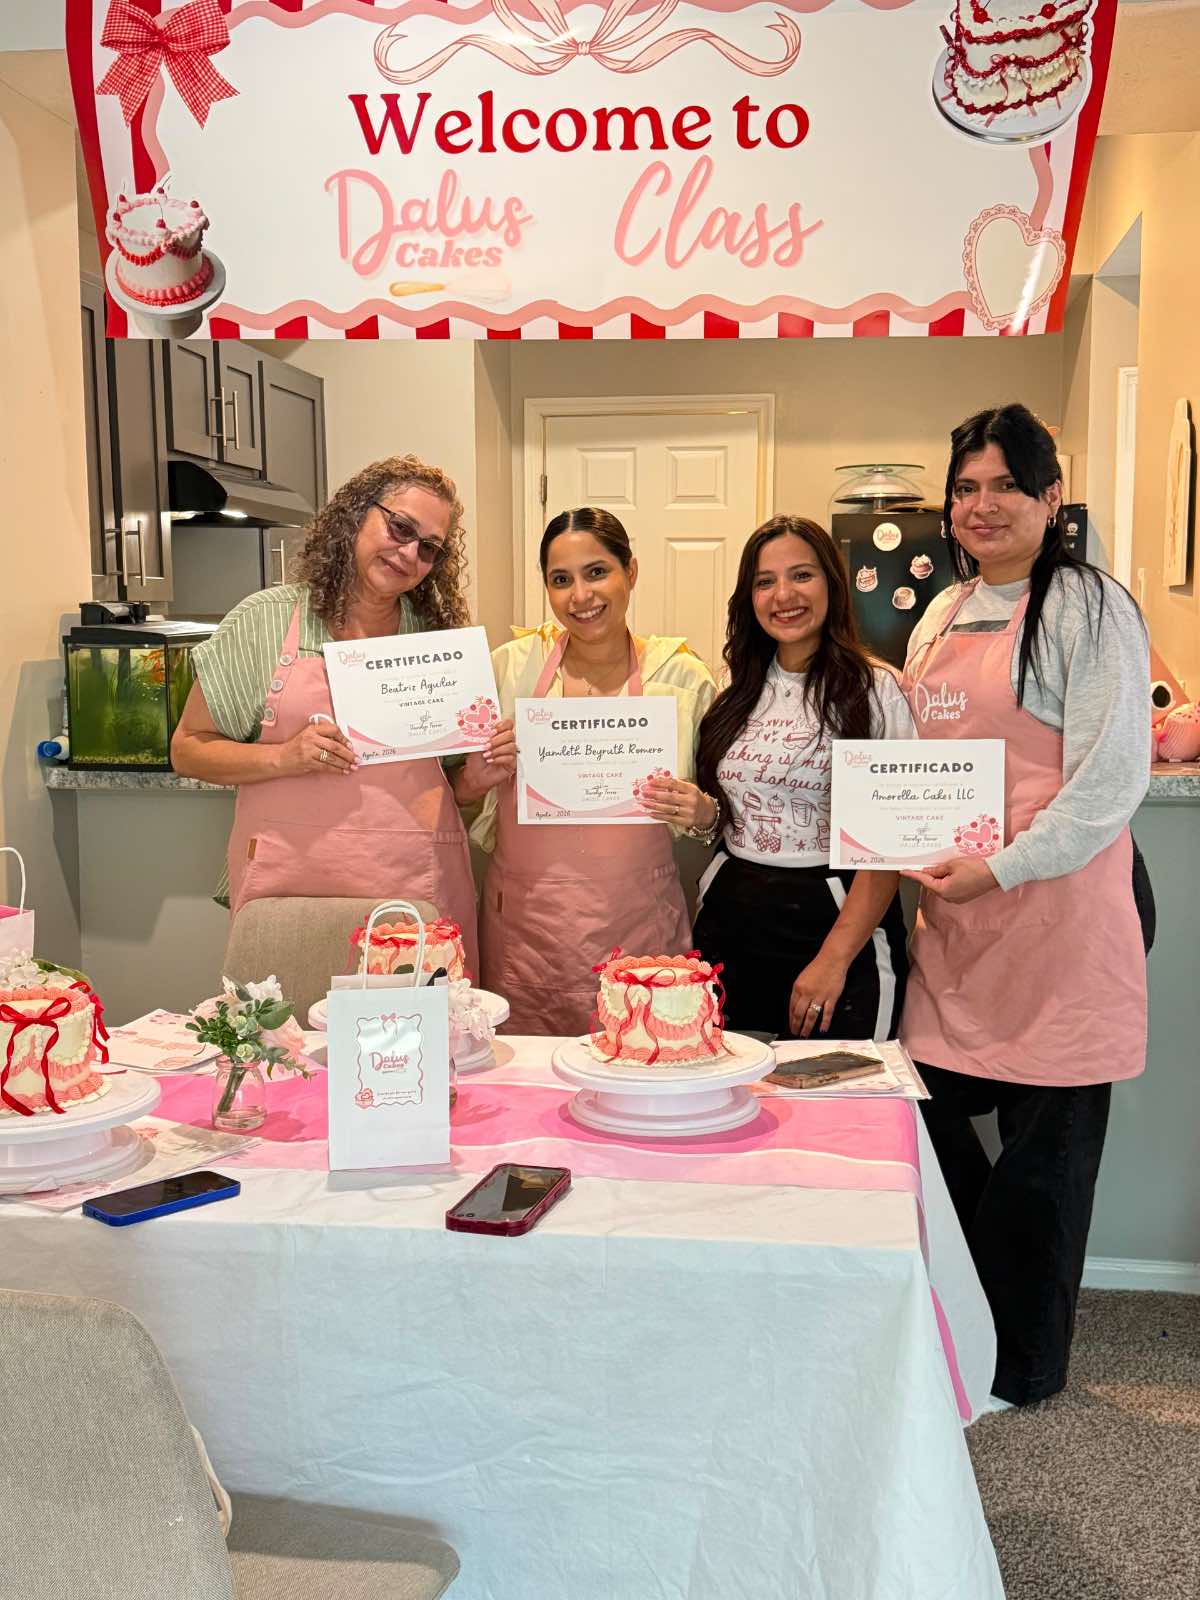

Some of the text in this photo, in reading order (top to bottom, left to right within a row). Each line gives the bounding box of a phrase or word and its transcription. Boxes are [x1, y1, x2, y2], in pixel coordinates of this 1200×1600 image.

[347, 89, 810, 155] Welcome to
[324, 154, 824, 276] Dalus Class
[395, 239, 503, 268] Cakes
[365, 650, 464, 671] CERTIFICADO
[381, 681, 416, 695] Beatriz
[420, 676, 457, 694] Aguilar
[915, 682, 968, 724] Dalus
[551, 717, 649, 731] CERTIFICADO
[930, 709, 961, 721] Cakes
[629, 743, 664, 754] Romero
[726, 745, 832, 775] aking is my
[870, 762, 974, 774] CERTIFICADO
[719, 764, 832, 793] ove Languag
[871, 788, 976, 801] Amorella Cakes LLC
